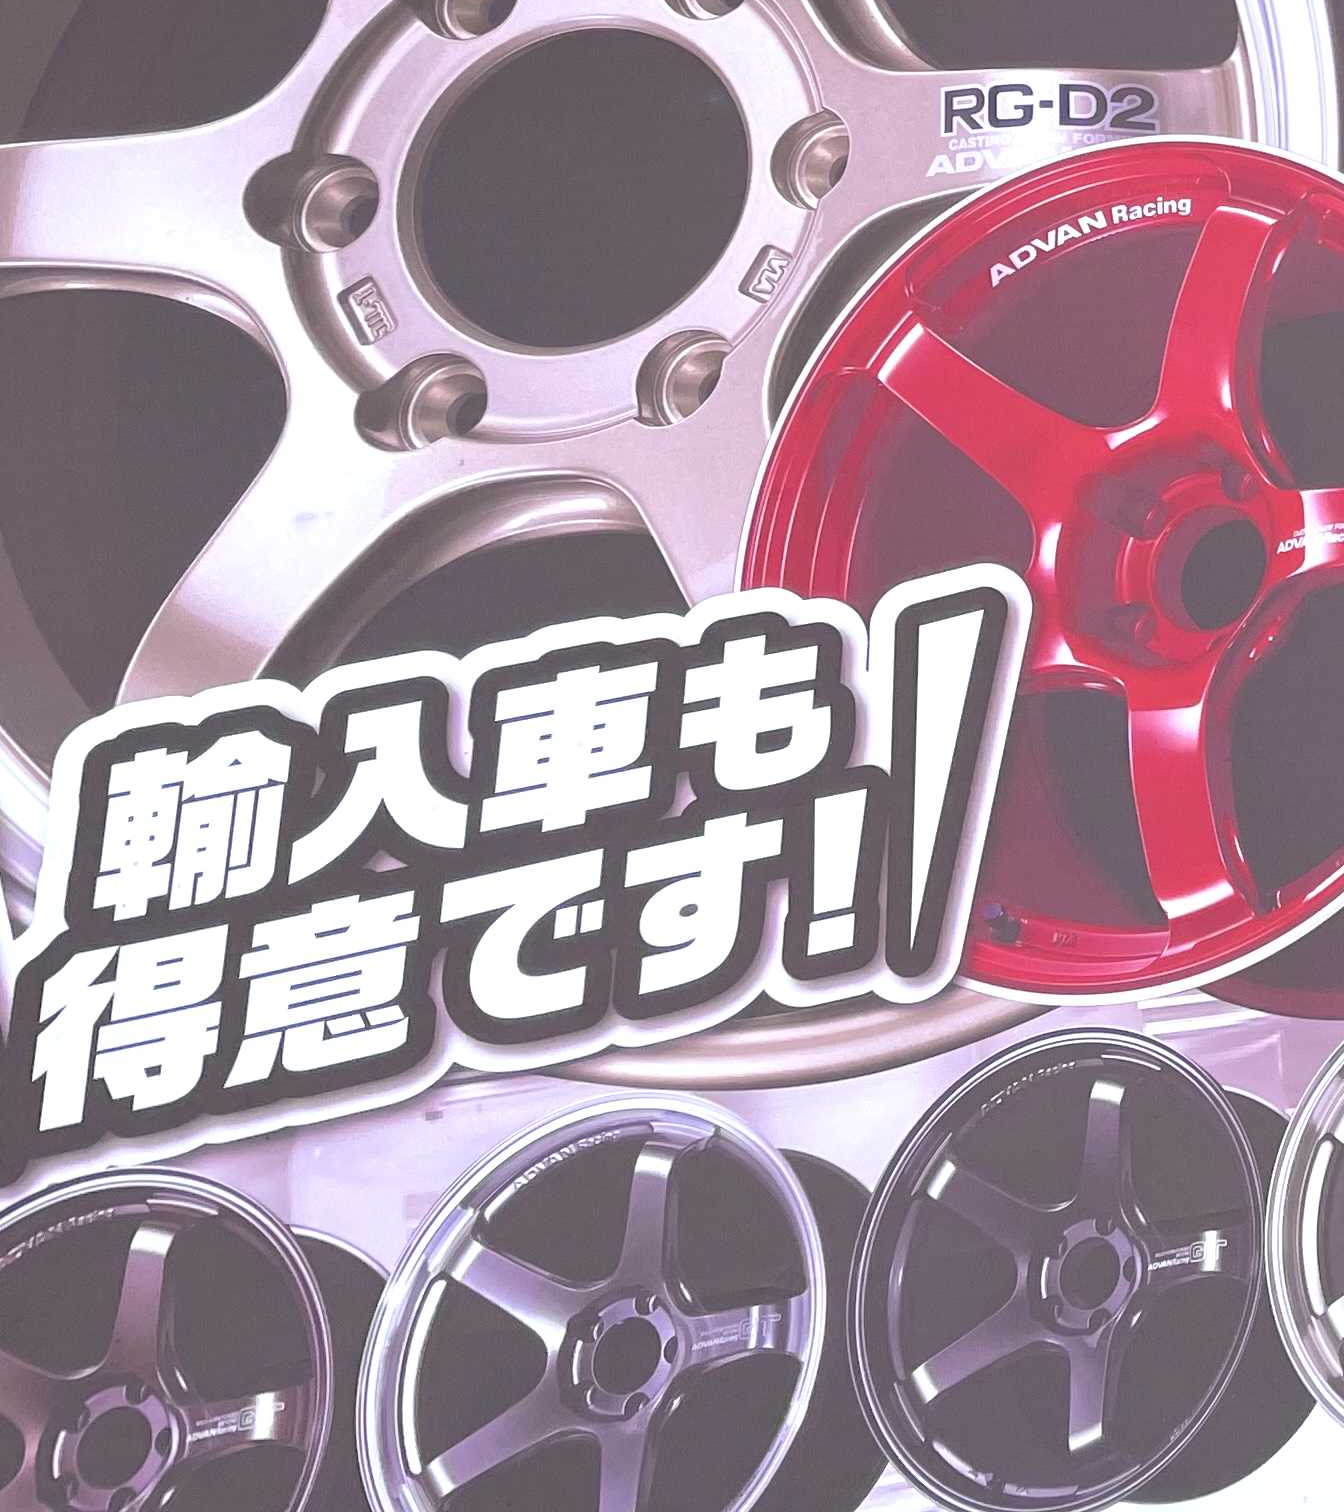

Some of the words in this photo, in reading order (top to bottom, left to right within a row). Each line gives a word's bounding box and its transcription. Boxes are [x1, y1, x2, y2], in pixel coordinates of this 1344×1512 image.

[942, 81, 1157, 136] RG-D2
[988, 210, 1108, 288] ADVAN
[1111, 194, 1192, 225] Racing
[95, 633, 833, 923] 輸入車も
[31, 788, 869, 1133] 得意です!
